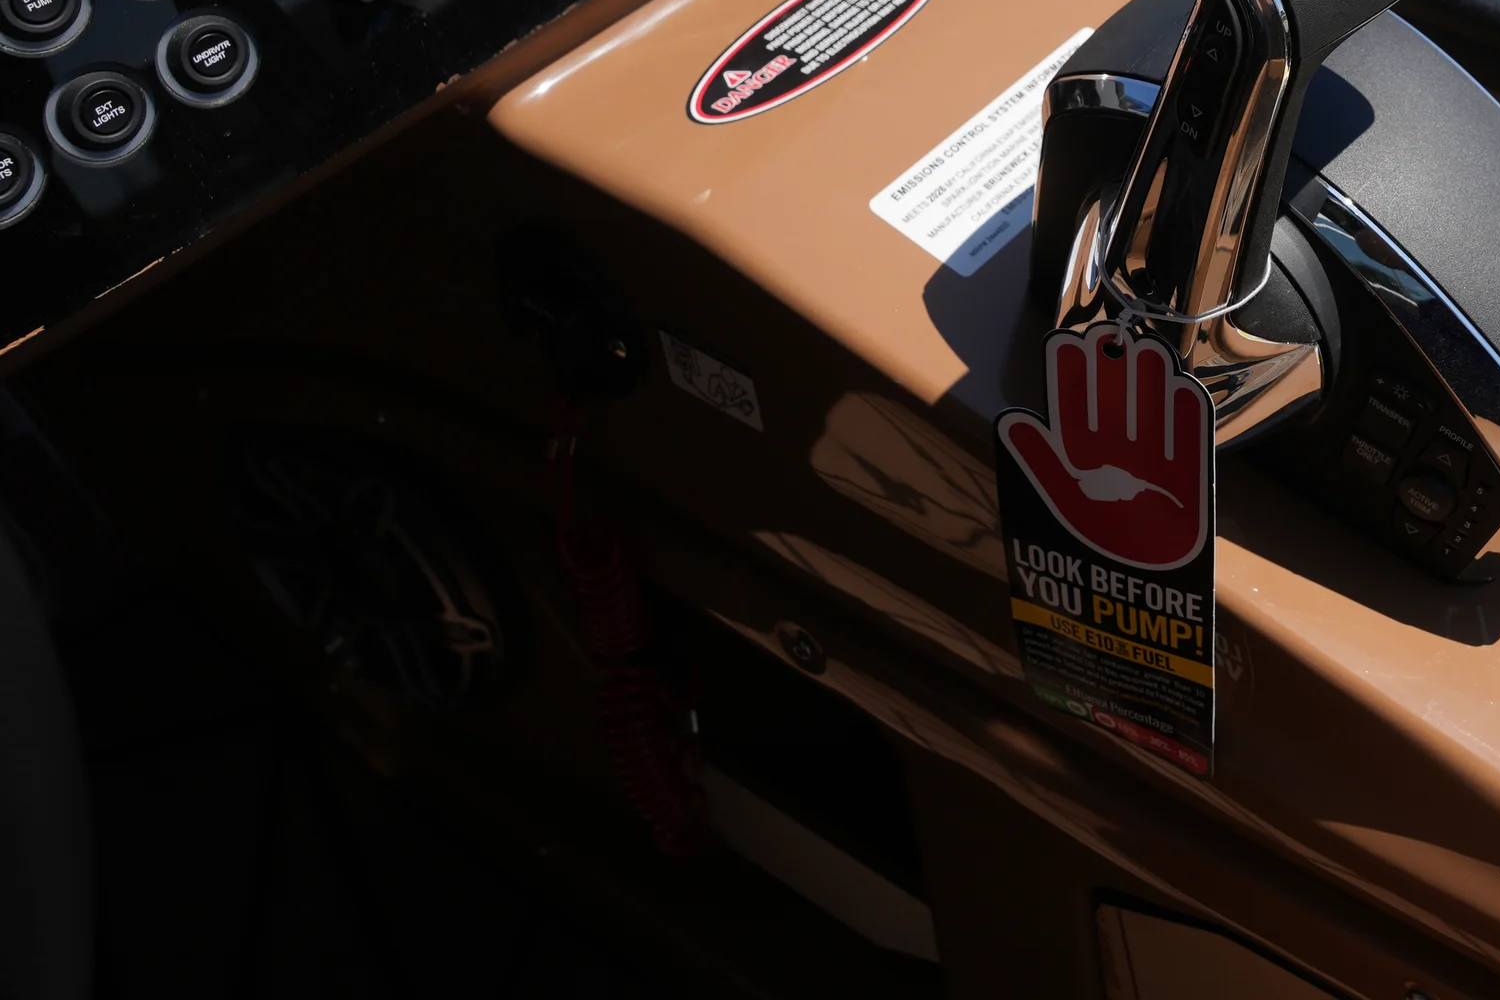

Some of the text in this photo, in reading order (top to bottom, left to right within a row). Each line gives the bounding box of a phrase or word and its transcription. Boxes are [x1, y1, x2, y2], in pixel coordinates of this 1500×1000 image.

[1216, 21, 1232, 37] UP
[193, 40, 231, 63] UNDRWTR
[205, 51, 226, 68] LIGHT
[711, 54, 796, 114] DANGER
[93, 105, 126, 128] LIGHTS
[95, 101, 113, 115] EXT
[1181, 122, 1198, 139] DN
[891, 156, 945, 201] EMISSIONS
[944, 122, 989, 158] CONTROL
[988, 92, 1025, 122] SYSTEM
[983, 151, 1030, 190] BRUNSWICK
[1368, 396, 1410, 428] TRANSFER
[1439, 425, 1474, 451] PROFILE
[1351, 435, 1393, 465] THROTTLE
[1356, 448, 1381, 464] ONLY
[1407, 488, 1439, 510] ACTIVE
[1477, 487, 1484, 495] 5
[1410, 499, 1431, 515] TRIM
[1471, 505, 1477, 513] 4
[1455, 535, 1462, 543] 2
[1013, 538, 1203, 622] LOOK BEFORE
[1017, 567, 1203, 656] YOU PUMP!
[1050, 614, 1082, 640] USE
[1086, 628, 1114, 652] E10
[1133, 647, 1176, 672] FUEL
[1066, 684, 1108, 712] Ethanol
[1110, 702, 1174, 734] Percentage
